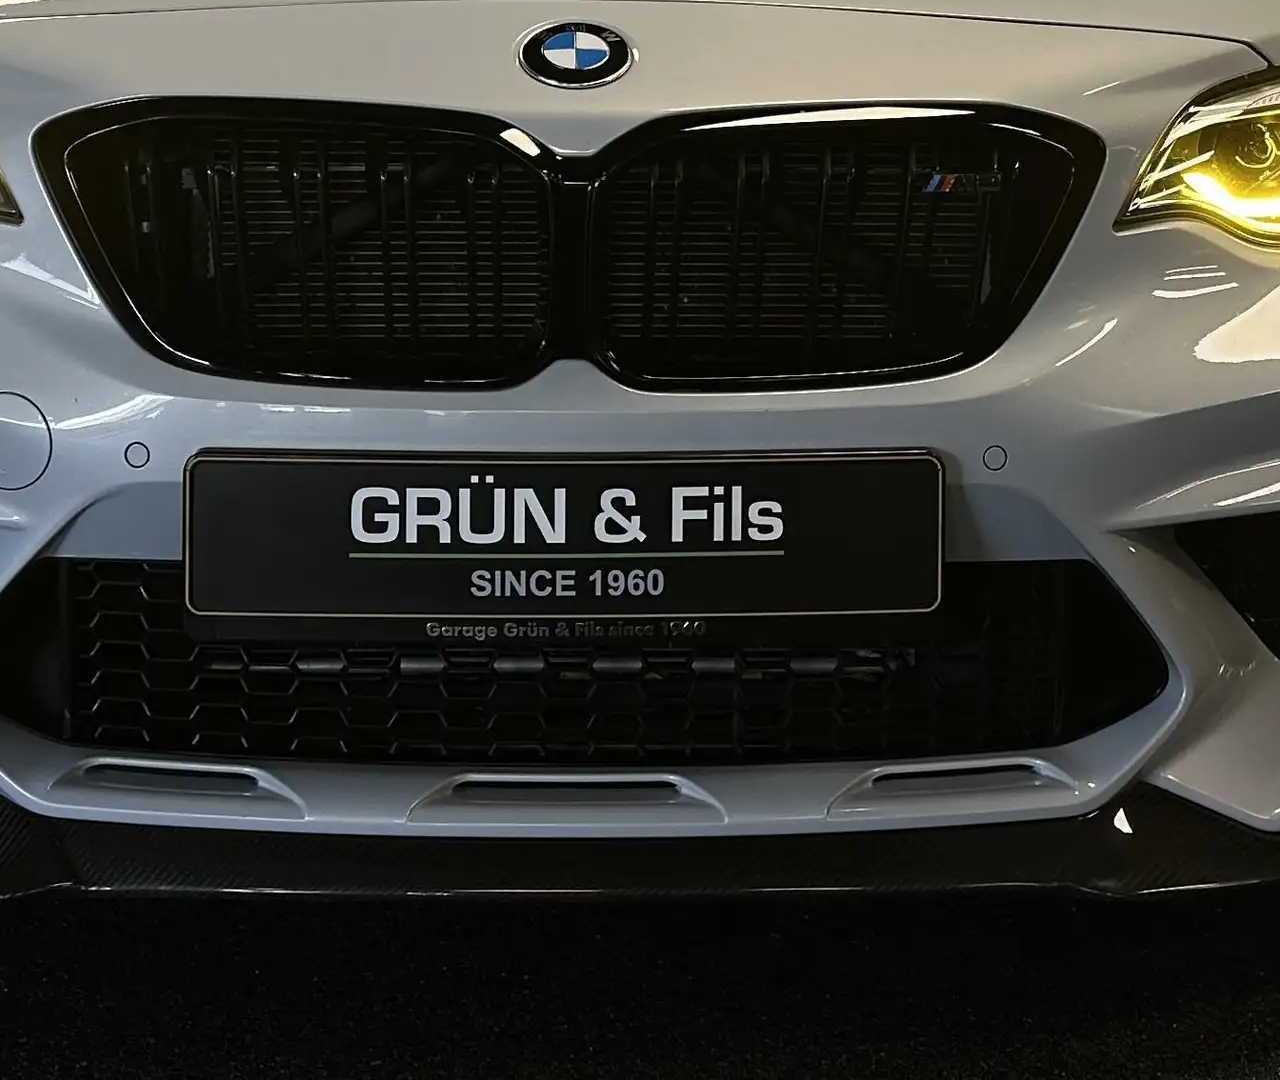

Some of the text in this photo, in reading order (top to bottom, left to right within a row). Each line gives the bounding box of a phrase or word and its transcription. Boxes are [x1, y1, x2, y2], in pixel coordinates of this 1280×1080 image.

[349, 475, 785, 545] GRÜN & Fils
[469, 568, 665, 598] SINCE 1960
[425, 620, 707, 641] Garage Grün & Fils since 1960
